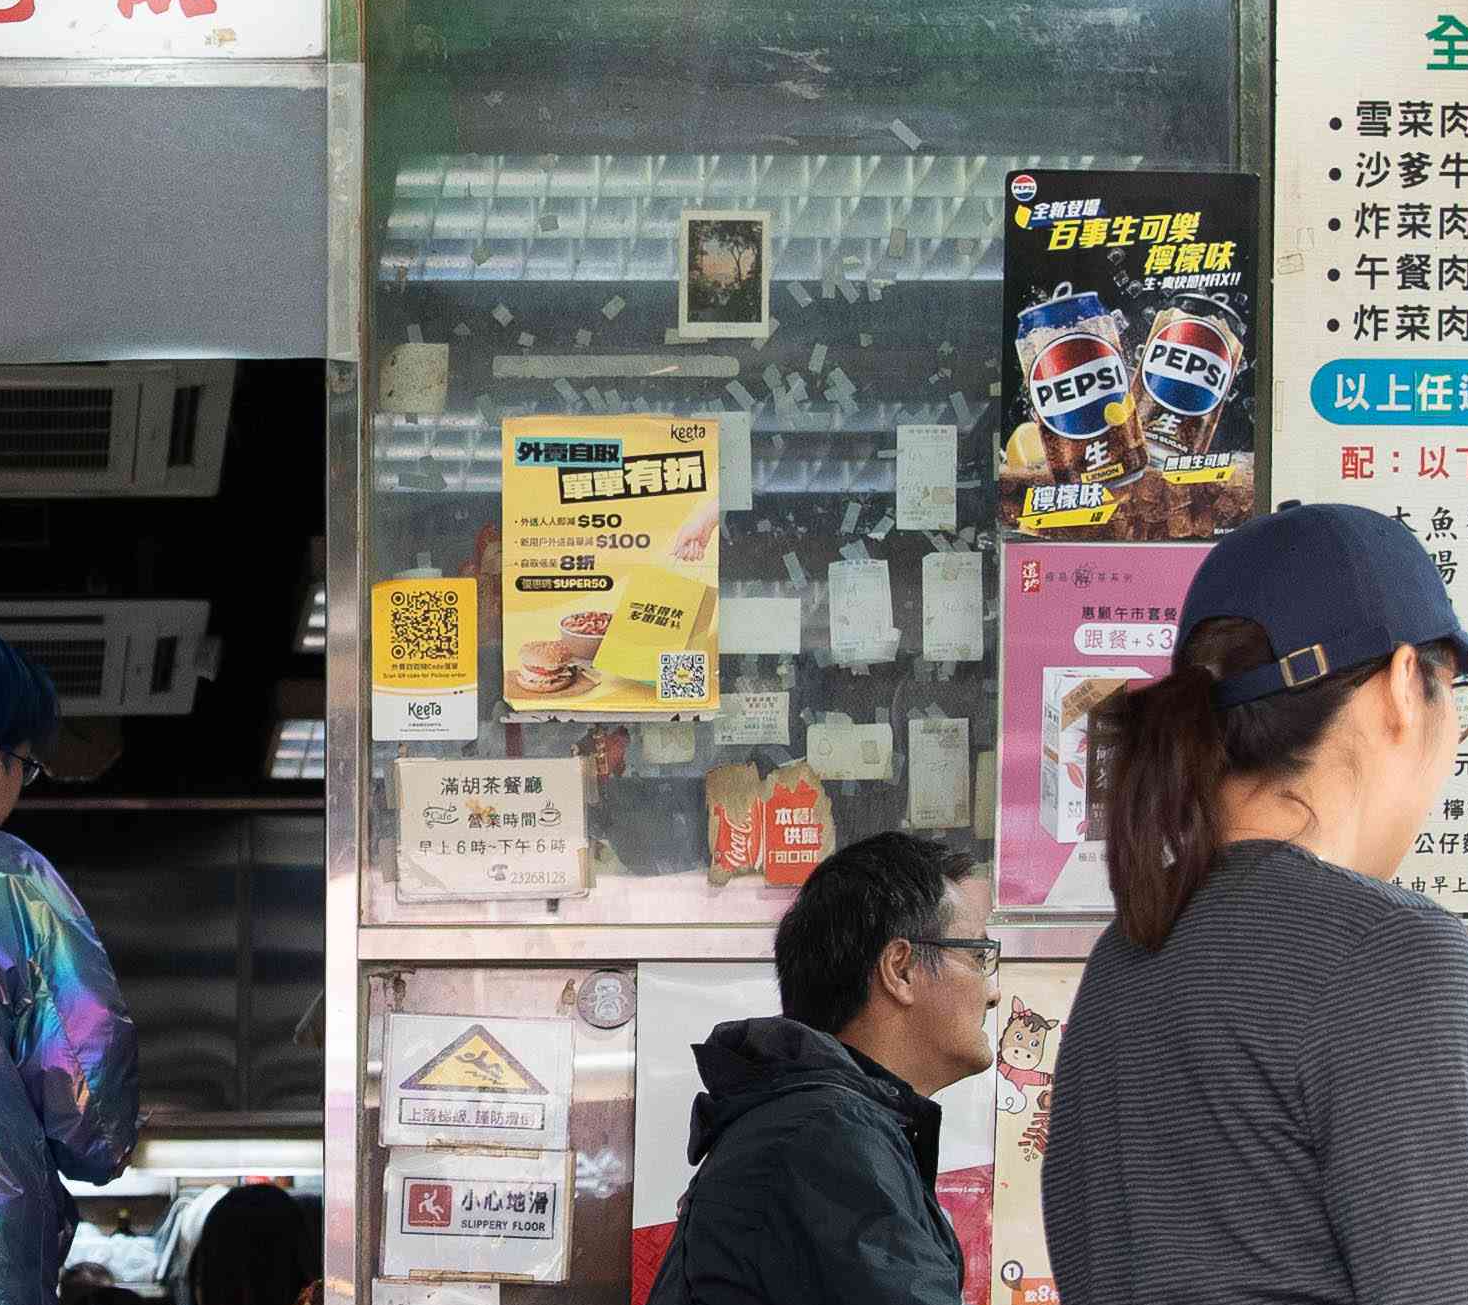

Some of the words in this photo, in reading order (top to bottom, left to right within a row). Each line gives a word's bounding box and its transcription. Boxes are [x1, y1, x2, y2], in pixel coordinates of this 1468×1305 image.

[1012, 183, 1037, 194] PEPSI
[1031, 198, 1101, 222] 全新登場
[1048, 211, 1201, 251] 百事生可樂
[1145, 241, 1237, 275] 檸檬味
[1149, 342, 1226, 391] PEPSI
[1036, 364, 1124, 408] PEPSI
[516, 441, 620, 464] 外賣自取
[561, 455, 703, 500] 單單有折
[1031, 483, 1105, 512] 檸檬味
[577, 513, 622, 529] $50
[595, 533, 651, 549] $100
[559, 554, 595, 571] 8折
[553, 577, 608, 590] SUPER50
[440, 776, 544, 796] 滿胡茶餐廳
[468, 810, 537, 829] 營業時間
[510, 870, 567, 885] 23268128
[460, 1188, 548, 1215] 小心地滑
[460, 1218, 509, 1233] SLIPPERY
[511, 1219, 547, 1233] FLOOR
